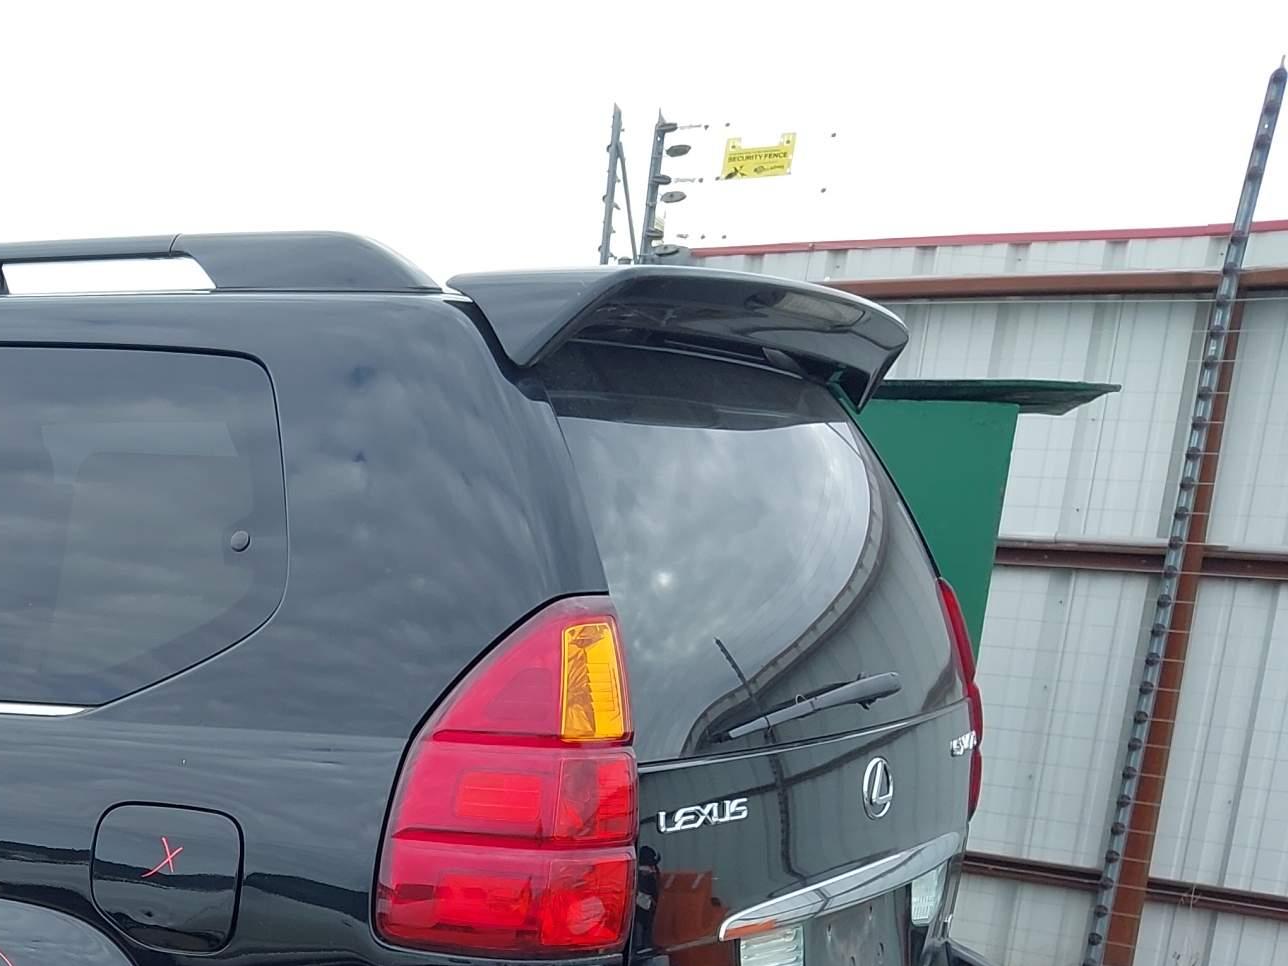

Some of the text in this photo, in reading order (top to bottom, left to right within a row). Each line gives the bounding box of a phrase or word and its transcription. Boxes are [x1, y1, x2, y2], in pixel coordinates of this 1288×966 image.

[728, 154, 763, 163] SECURITY
[764, 151, 788, 160] FENCE
[657, 797, 748, 832] LEXUS
